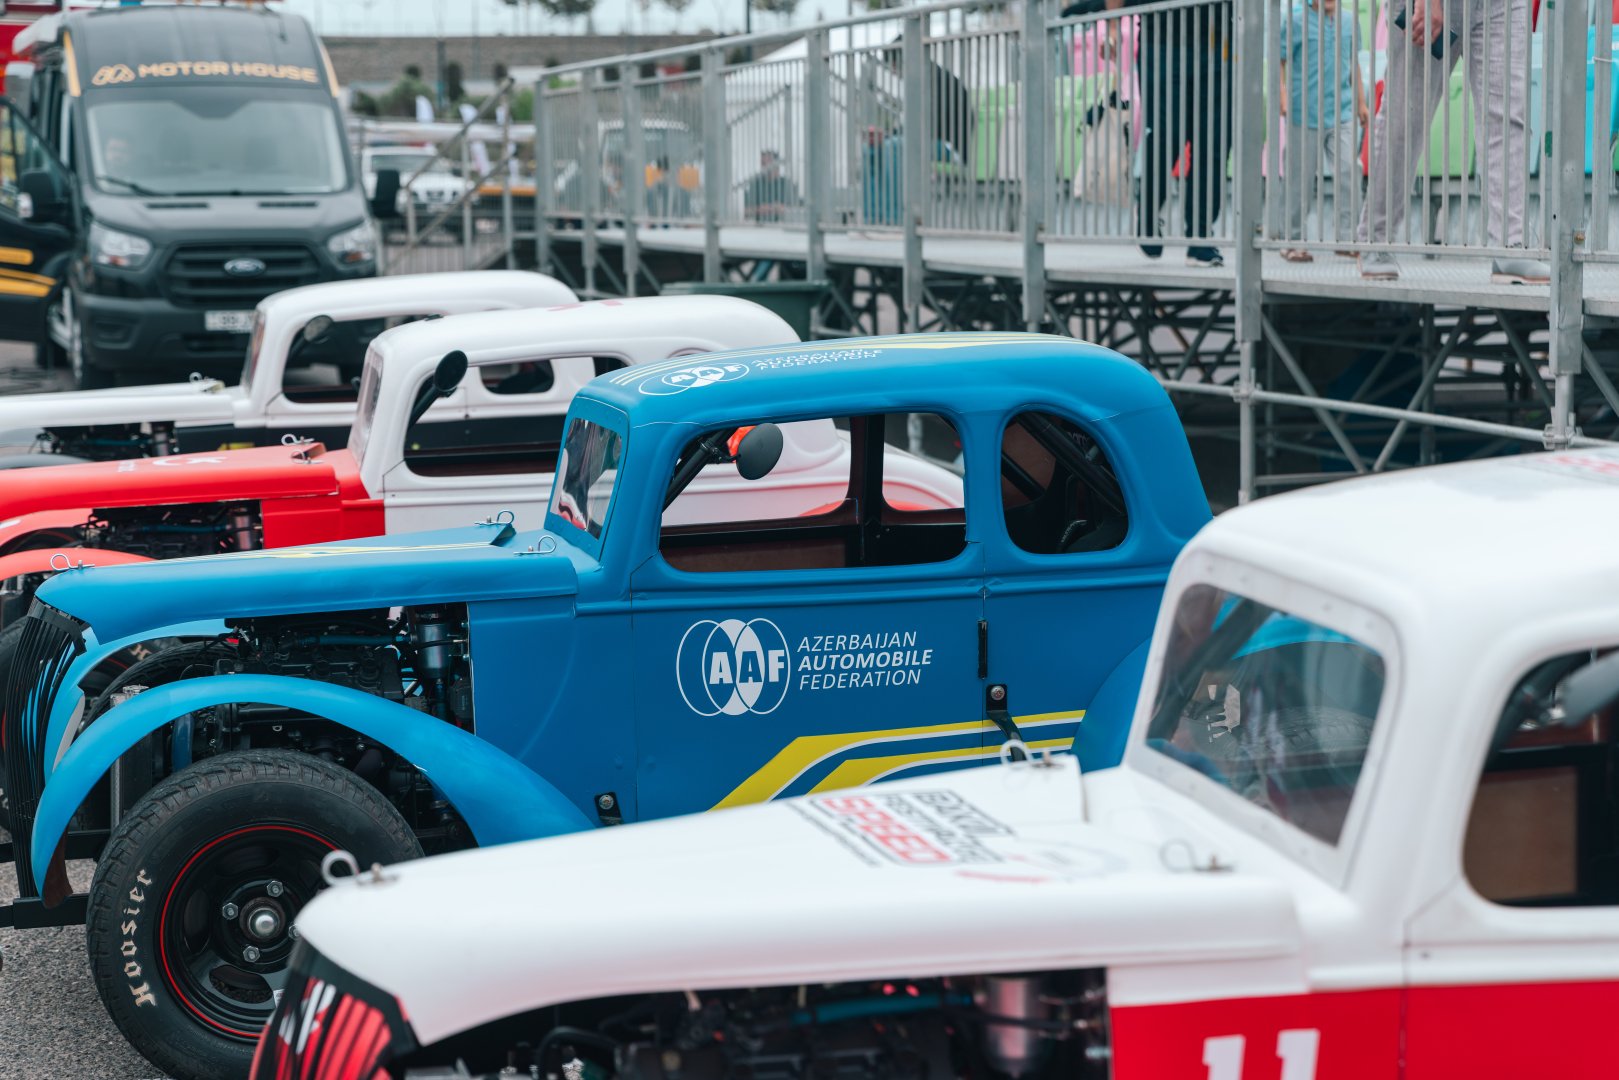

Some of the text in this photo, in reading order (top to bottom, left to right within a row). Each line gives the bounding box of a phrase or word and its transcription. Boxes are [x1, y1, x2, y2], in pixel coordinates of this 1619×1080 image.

[138, 61, 319, 83] MOTOR HOUSE
[797, 631, 917, 652] AZERBAIJAN
[709, 649, 785, 685] AAF
[797, 649, 933, 672] AUTOMOBILE
[799, 669, 922, 690] FEDERATION
[120, 868, 157, 1007] Hoosier
